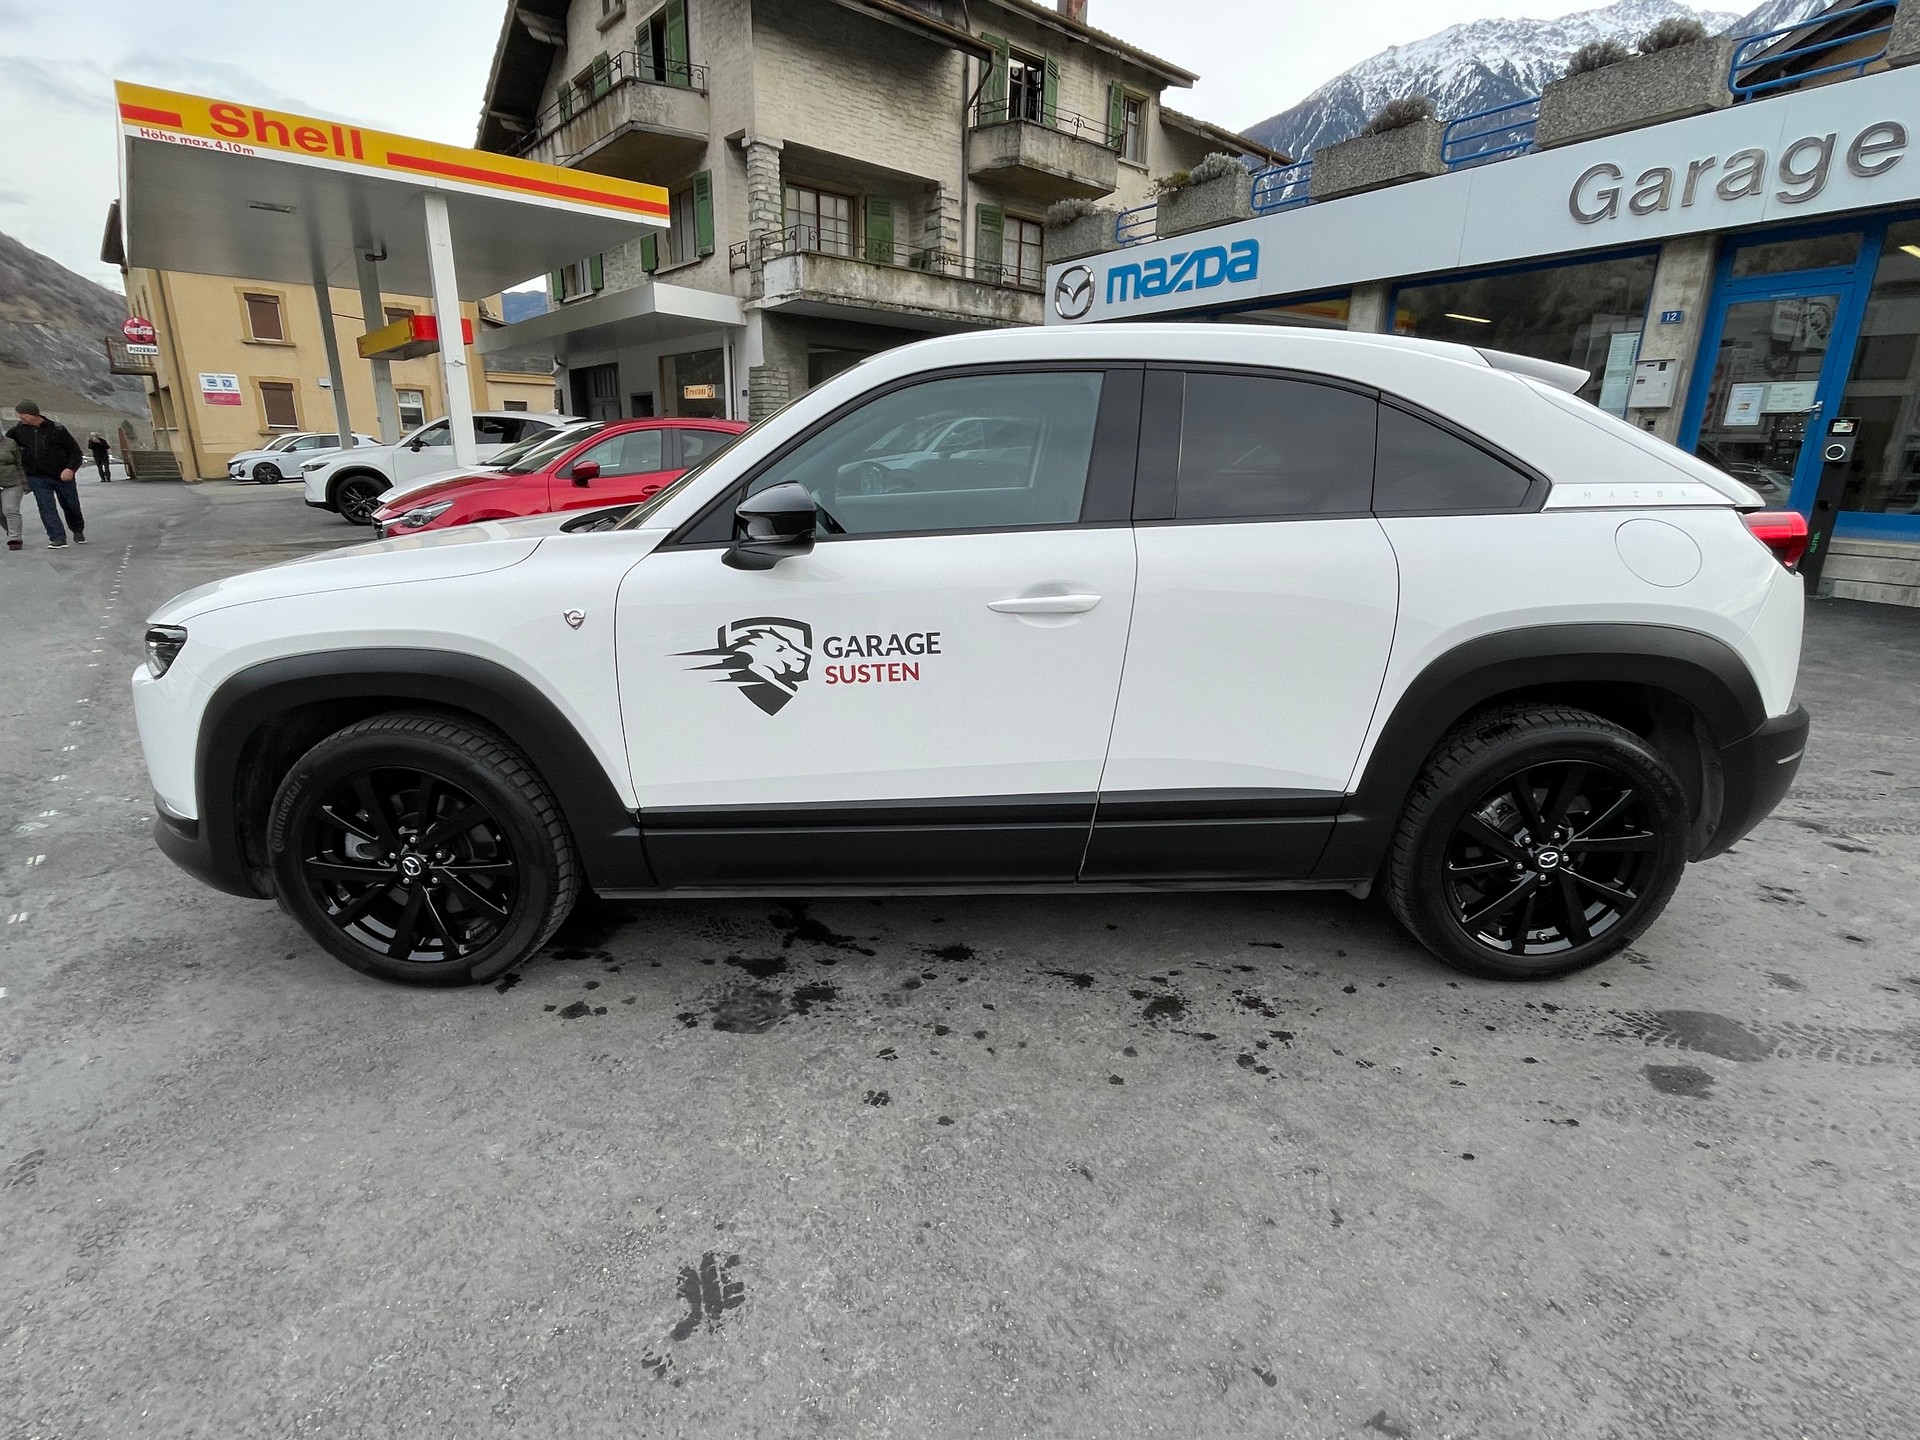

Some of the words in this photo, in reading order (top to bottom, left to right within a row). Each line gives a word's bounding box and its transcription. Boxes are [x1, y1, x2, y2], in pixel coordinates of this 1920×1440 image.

[140, 127, 176, 143] Höhe
[180, 137, 213, 149] max.
[209, 103, 364, 160] Shell
[1568, 121, 1909, 224] Garage
[1666, 312, 1677, 322] 12
[1583, 490, 1687, 499] MAZDA
[823, 632, 942, 659] GARAGE
[825, 662, 921, 685] SUSTEN
